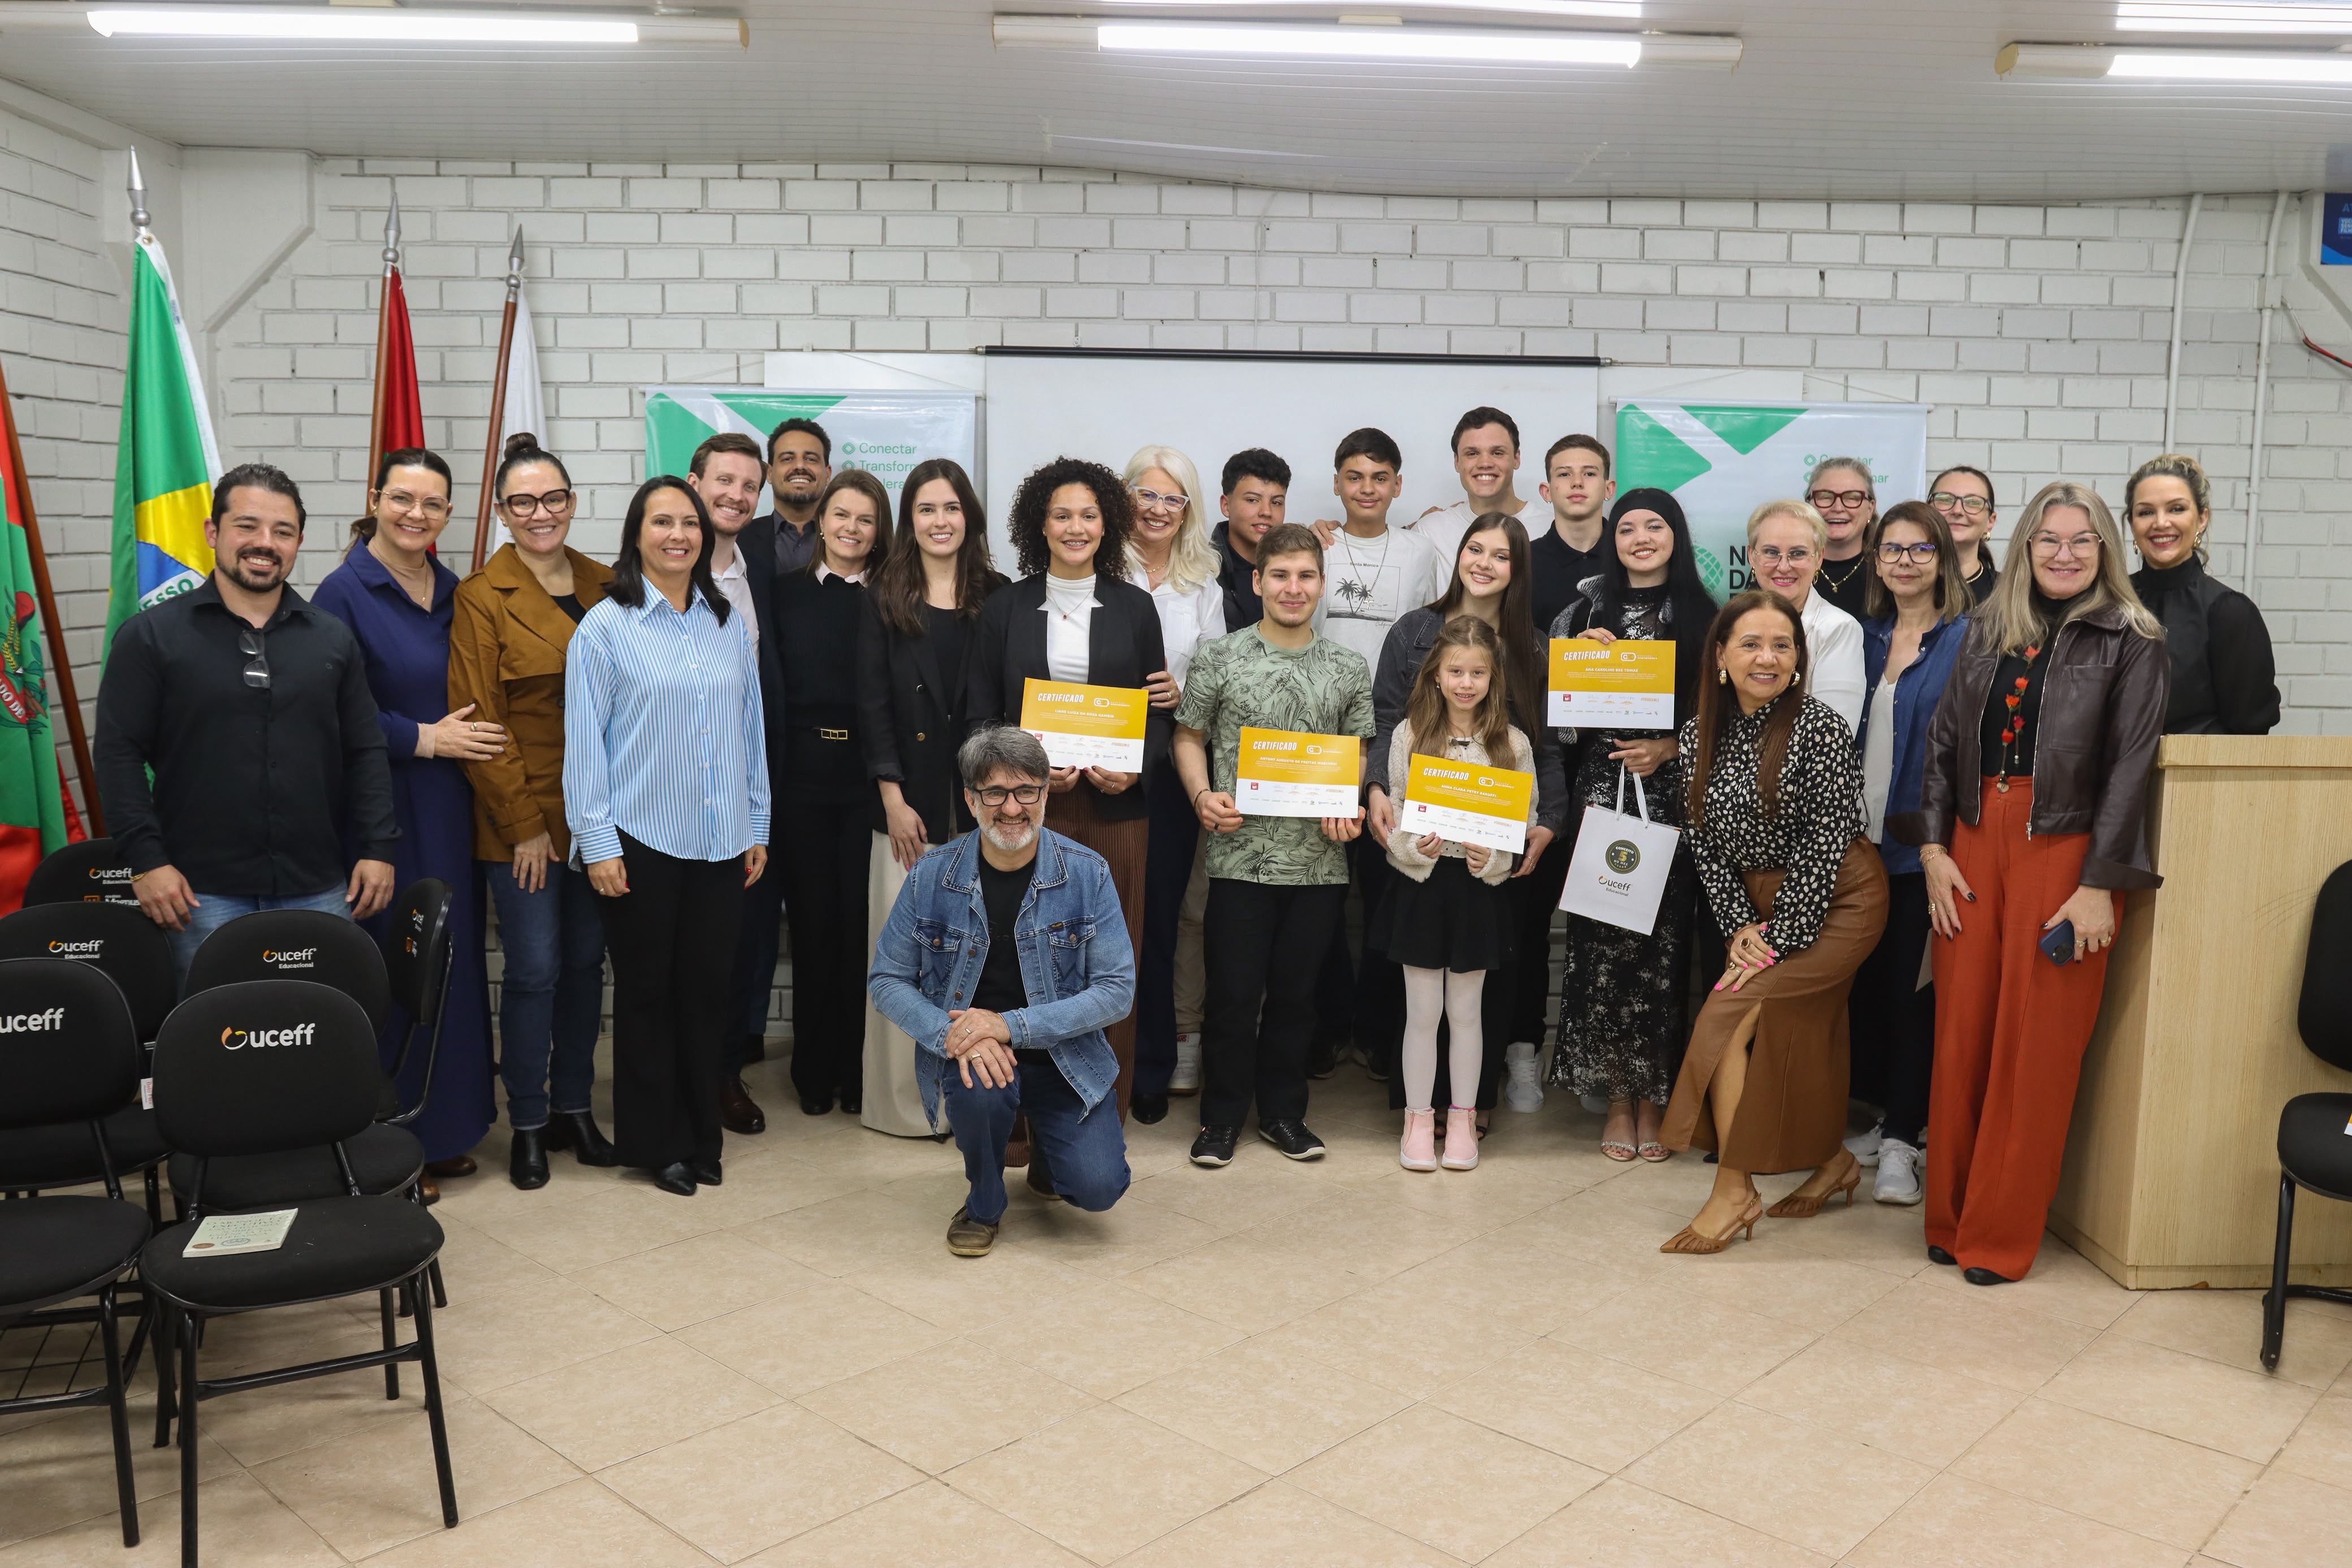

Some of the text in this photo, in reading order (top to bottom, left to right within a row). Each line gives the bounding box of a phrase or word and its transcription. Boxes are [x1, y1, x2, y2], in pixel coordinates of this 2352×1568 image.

[859, 443, 917, 454] Conectar
[859, 460, 919, 471] Transfor
[1563, 650, 1611, 661] CERTIFICADO
[1037, 693, 1084, 703] CERTIFICADO
[1253, 741, 1297, 751] CERTIFICADO
[1423, 768, 1469, 781] CERTIFICADO
[1619, 851, 1628, 861] 5
[1607, 880, 1631, 891] uceff
[1606, 887, 1629, 896] Educacional
[64, 940, 101, 952] uceff
[278, 948, 314, 961] uceff
[249, 1023, 315, 1048] uceff
